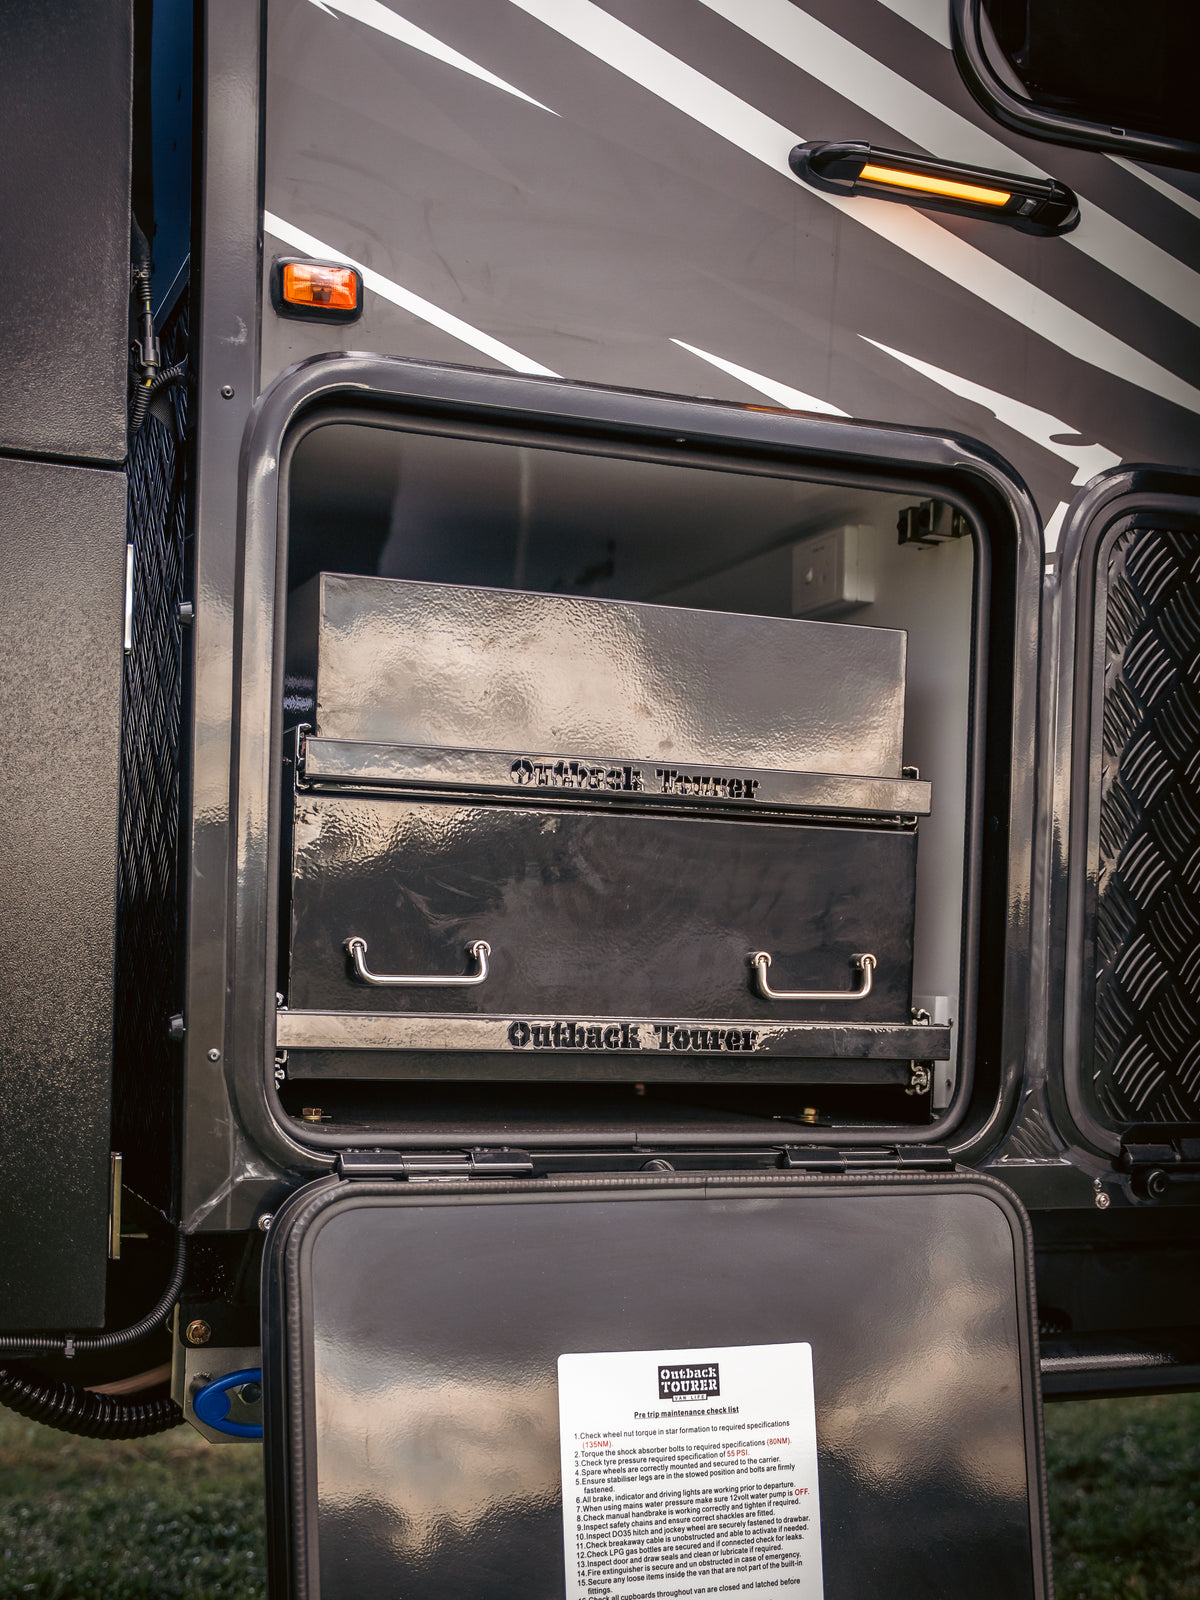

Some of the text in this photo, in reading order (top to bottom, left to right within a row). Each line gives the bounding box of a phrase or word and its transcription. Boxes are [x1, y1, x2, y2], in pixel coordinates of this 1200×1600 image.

[510, 758, 760, 799] Outback Tourer
[507, 1021, 760, 1052] Outback Tourer
[660, 1367, 717, 1380] Outback
[661, 1379, 718, 1393] TOURER
[647, 1410, 660, 1419] trip
[661, 1409, 705, 1417] maintenance
[707, 1407, 727, 1415] check
[603, 1429, 622, 1438] wheel
[624, 1429, 634, 1437] nut
[636, 1428, 657, 1437] torque
[680, 1425, 710, 1433] formation
[719, 1422, 746, 1433] required
[747, 1420, 790, 1431] specifications
[617, 1446, 637, 1455] shock
[638, 1445, 667, 1454] absorber
[669, 1444, 684, 1452] bolts
[694, 1441, 720, 1452] required
[722, 1439, 765, 1450] specifications
[603, 1466, 626, 1474] wheels
[640, 1463, 669, 1472] correctly
[670, 1461, 698, 1470] mounted
[700, 1460, 712, 1468] and
[713, 1458, 739, 1467] secured
[604, 1458, 617, 1467] tyre
[618, 1457, 647, 1466] pressure
[648, 1454, 676, 1464] required
[677, 1451, 718, 1462] specification
[607, 1474, 638, 1483] stabiliser
[639, 1473, 653, 1482] legs
[685, 1469, 708, 1478] stowed
[710, 1468, 735, 1478] position
[736, 1466, 748, 1474] and
[750, 1465, 765, 1473] bolts
[778, 1463, 795, 1473] firmly
[615, 1492, 644, 1501] indicator
[646, 1490, 658, 1499] and
[659, 1489, 682, 1498] driving
[683, 1488, 701, 1498] lights
[714, 1485, 739, 1494] working
[740, 1484, 755, 1494] prior
[604, 1502, 622, 1512] using
[623, 1501, 643, 1509] mains
[644, 1499, 664, 1508] water
[665, 1498, 694, 1508] pressure
[695, 1496, 713, 1504] make
[729, 1492, 749, 1501] 12volt
[750, 1492, 768, 1500] water
[769, 1491, 786, 1500] pump
[606, 1510, 630, 1519] manual
[632, 1508, 667, 1518] handbrake
[674, 1506, 701, 1515] working
[702, 1504, 730, 1513] correctly
[731, 1502, 743, 1511] and
[744, 1501, 766, 1511] tighten
[610, 1520, 630, 1529] safety
[631, 1518, 653, 1527] chains
[654, 1517, 667, 1525] and
[692, 1513, 715, 1522] correct
[716, 1512, 744, 1520] shackles
[608, 1538, 645, 1547] breakaway
[646, 1535, 664, 1544] cable
[672, 1531, 715, 1542] unobstructed
[716, 1530, 728, 1538] and
[730, 1529, 744, 1537] able
[752, 1526, 777, 1535] activate
[609, 1547, 624, 1556] LPG
[626, 1548, 638, 1556] gas
[639, 1545, 662, 1553] bottles
[675, 1541, 702, 1551] secured
[702, 1540, 715, 1548] and
[721, 1537, 755, 1547] connected
[756, 1535, 775, 1544] check
[630, 1555, 642, 1563] and
[661, 1552, 679, 1560] seals
[680, 1551, 692, 1559] and
[720, 1546, 748, 1556] lubricate
[602, 1564, 644, 1575] extinguisher
[675, 1560, 688, 1568] and
